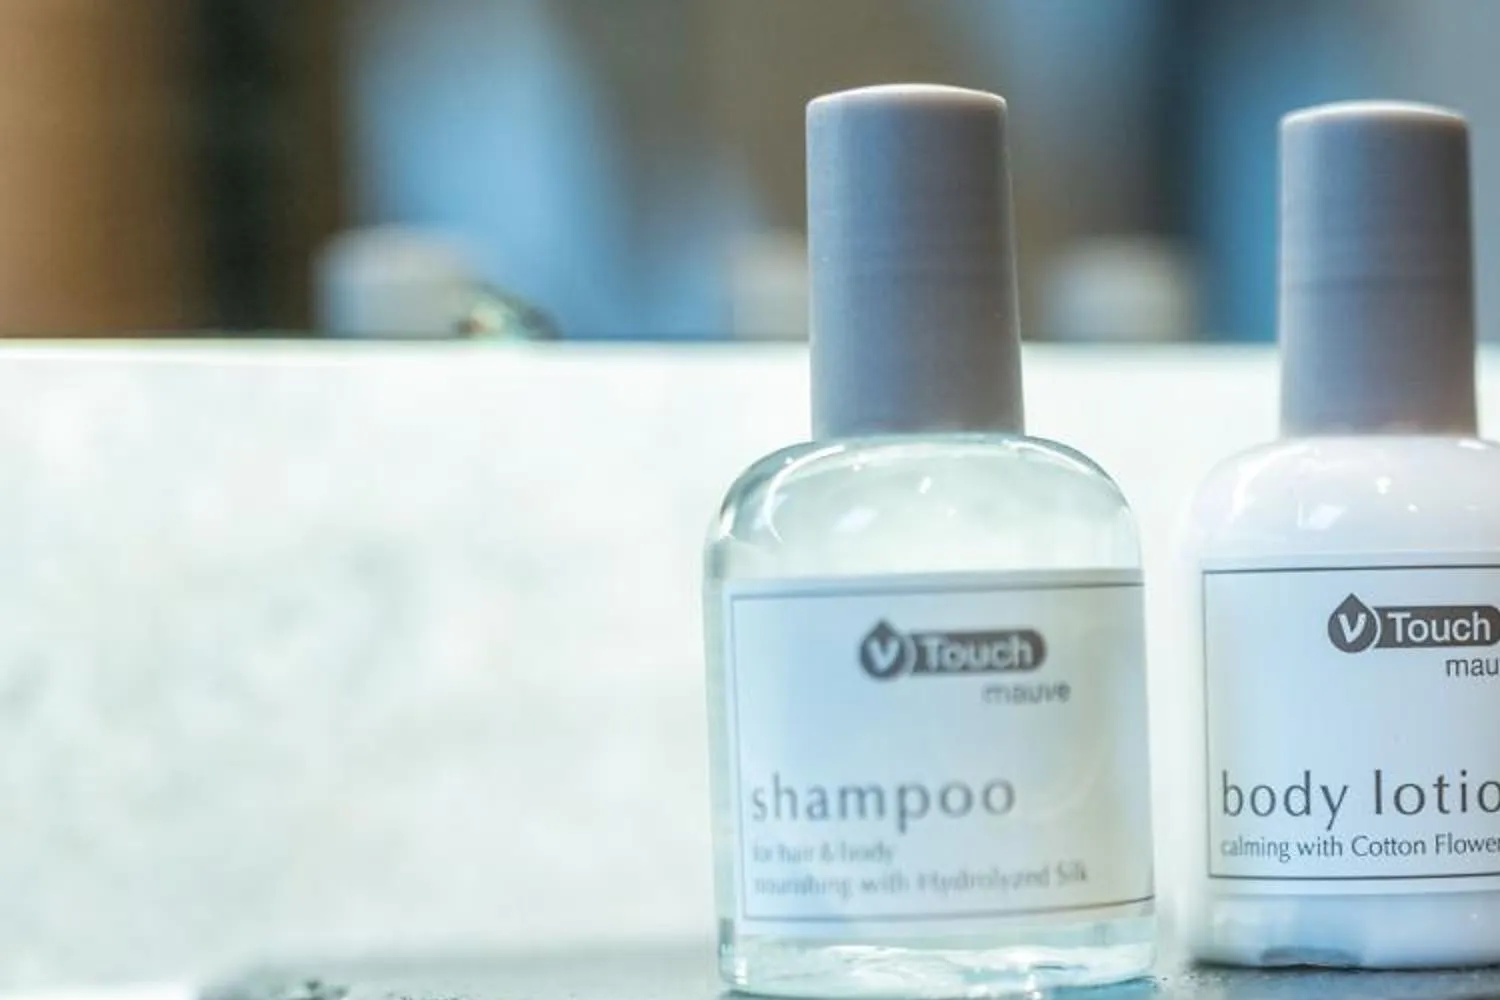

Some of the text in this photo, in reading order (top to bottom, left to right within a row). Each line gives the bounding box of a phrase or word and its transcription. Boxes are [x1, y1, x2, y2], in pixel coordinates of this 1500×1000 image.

[1336, 611, 1492, 644] V Touch
[865, 636, 1035, 672] V Touch
[981, 681, 1072, 705] mauve
[750, 771, 1018, 834] shampoo
[1221, 768, 1350, 832] body
[1220, 836, 1292, 864] calming
[1295, 834, 1344, 858] with
[1351, 834, 1427, 859] Cotton
[859, 868, 911, 895] with
[1056, 859, 1089, 886] Silk
